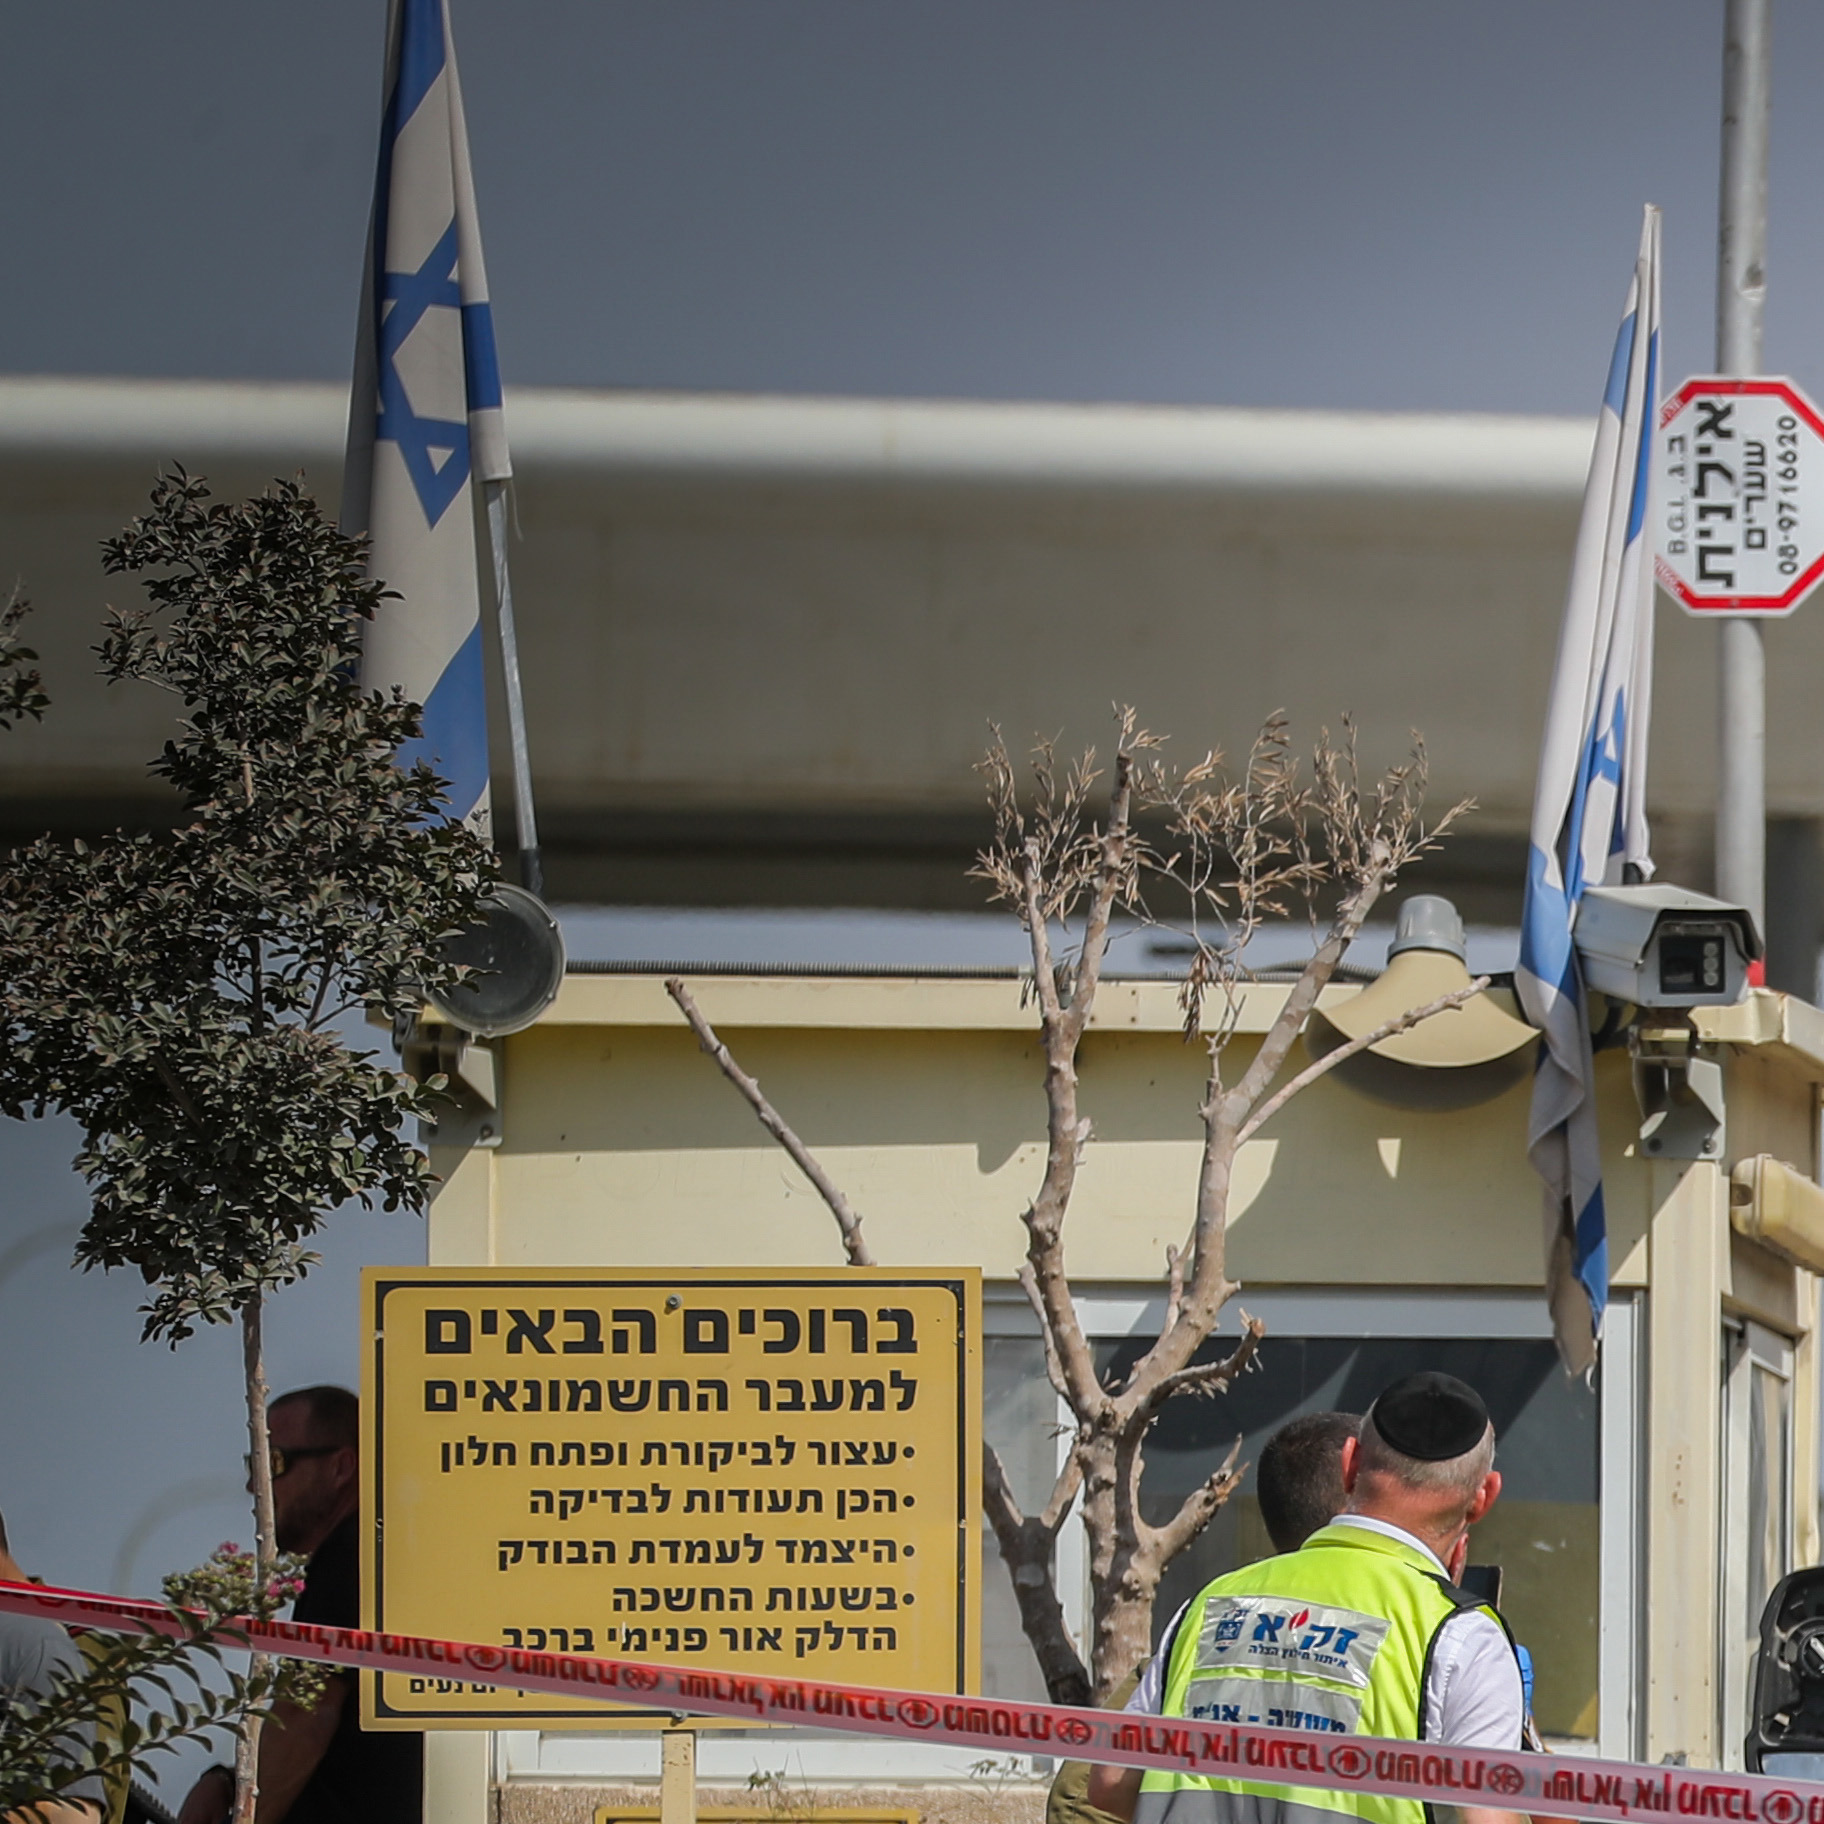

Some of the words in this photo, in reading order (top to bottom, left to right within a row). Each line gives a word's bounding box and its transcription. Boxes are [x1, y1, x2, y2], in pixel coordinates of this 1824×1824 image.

[1694, 402, 1734, 588] אילנית
[1745, 441, 1765, 549] שערים
[424, 1308, 657, 1355] הבאים
[683, 1307, 918, 1355] ברוכים
[424, 1378, 729, 1413] החשמונאים
[745, 1371, 918, 1412] למעבר
[440, 1435, 517, 1473] חלון
[530, 1440, 628, 1467] ופתח
[640, 1435, 797, 1473] לביקורת
[807, 1440, 898, 1467] עצור
[529, 1484, 672, 1521] לבדיקה
[683, 1488, 824, 1515] תעודות
[836, 1488, 898, 1520] הכן
[498, 1538, 617, 1571] הבודק
[628, 1533, 765, 1565] לעמדת
[775, 1538, 898, 1565] היצמד
[612, 1585, 753, 1612] החשכה
[765, 1585, 898, 1612] בשעות
[502, 1627, 596, 1652] ברכב
[607, 1627, 708, 1652] פנימי
[720, 1627, 784, 1652] אור
[796, 1621, 898, 1658] הדלק
[1111, 1723, 1196, 1766] ישראל
[1202, 1728, 1238, 1764] אין
[1246, 1737, 1326, 1773] מעבר
[1375, 1752, 1487, 1788] משטרת
[1543, 1770, 1628, 1816] ישראל
[1635, 1773, 1671, 1812] אין
[1678, 1782, 1758, 1821] מעבר
